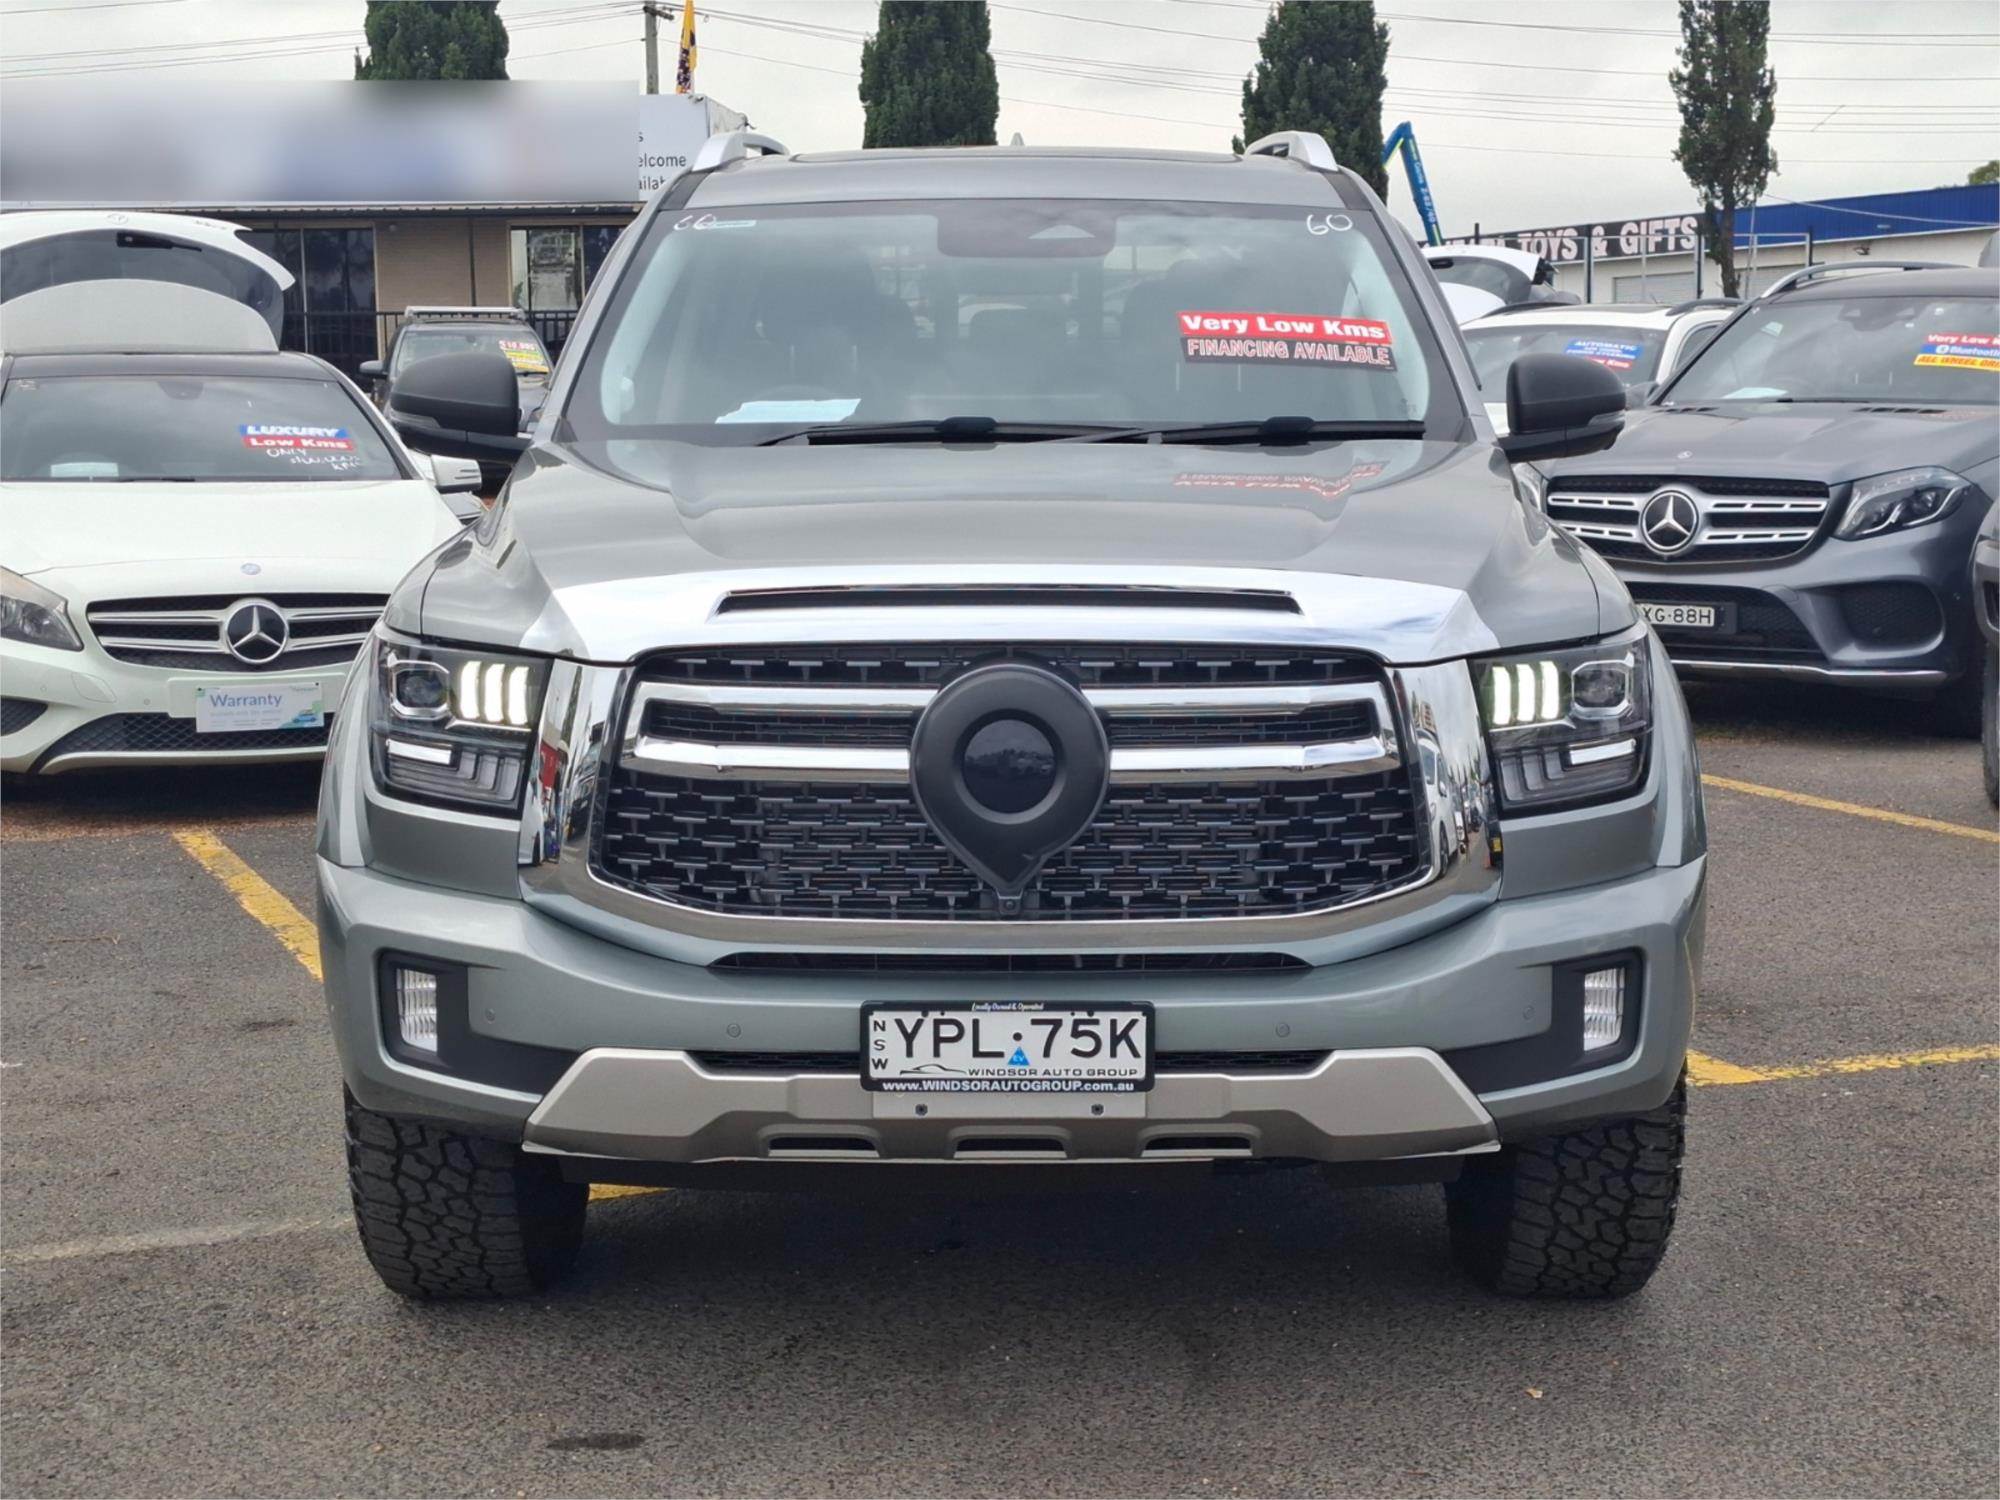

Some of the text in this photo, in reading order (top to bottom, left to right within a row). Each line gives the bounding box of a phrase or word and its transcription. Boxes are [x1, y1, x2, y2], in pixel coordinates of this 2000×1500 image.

[1306, 214, 1353, 235] 60
[1518, 216, 1699, 261] TOYS & GIFTS
[1181, 315, 1387, 339] Very Low Kms
[1928, 334, 1960, 344] Very
[1961, 335, 1990, 345] Low
[1187, 338, 1392, 366] FINANCING AVAILABLE
[246, 425, 340, 438] LUXURY
[249, 438, 349, 449] Low Kms
[210, 693, 283, 708] Warranty
[967, 1068, 1138, 1077] WINDSOR AUTO GROUP
[882, 1079, 1135, 1092] www.WINDSORAUTOGROUP.com.au
